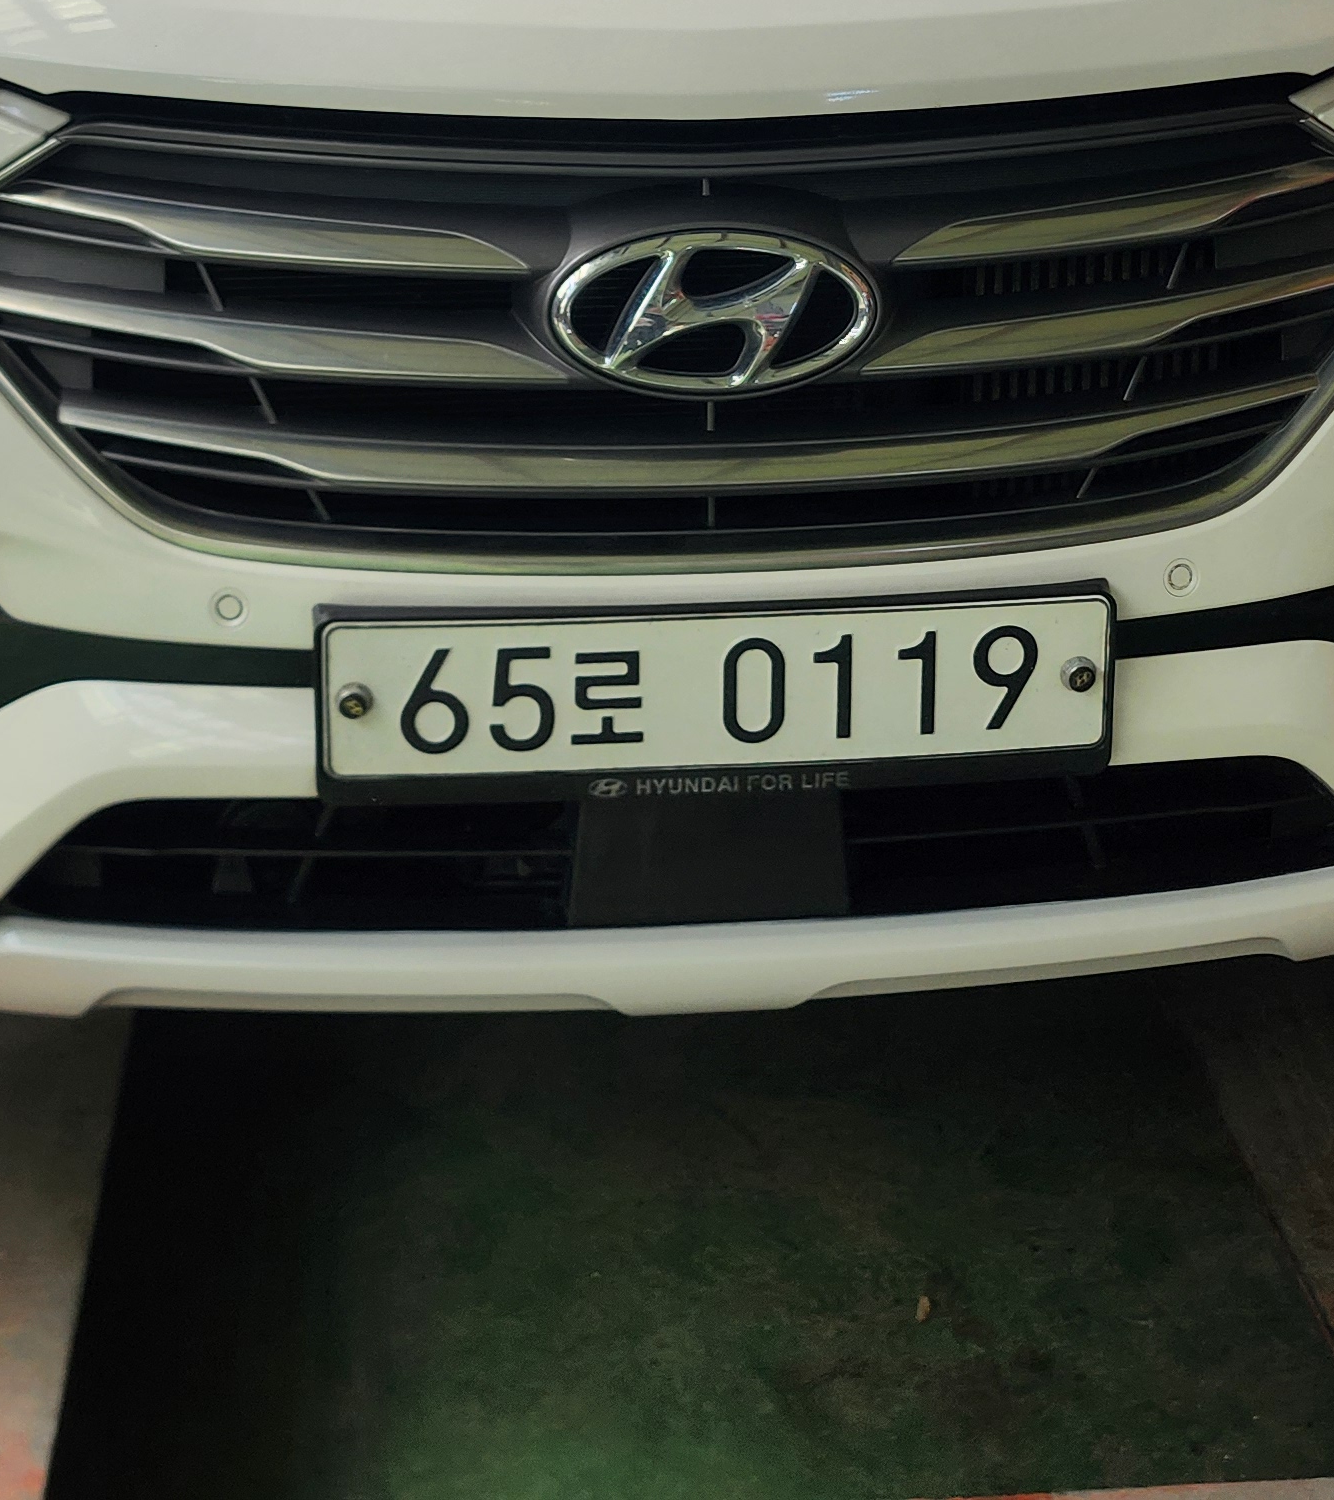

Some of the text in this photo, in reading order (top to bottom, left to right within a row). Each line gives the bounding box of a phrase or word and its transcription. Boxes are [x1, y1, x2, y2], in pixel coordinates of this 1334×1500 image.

[399, 625, 1039, 756] 65로 0119
[635, 770, 850, 796] HYUNDAI FOR LIFE
